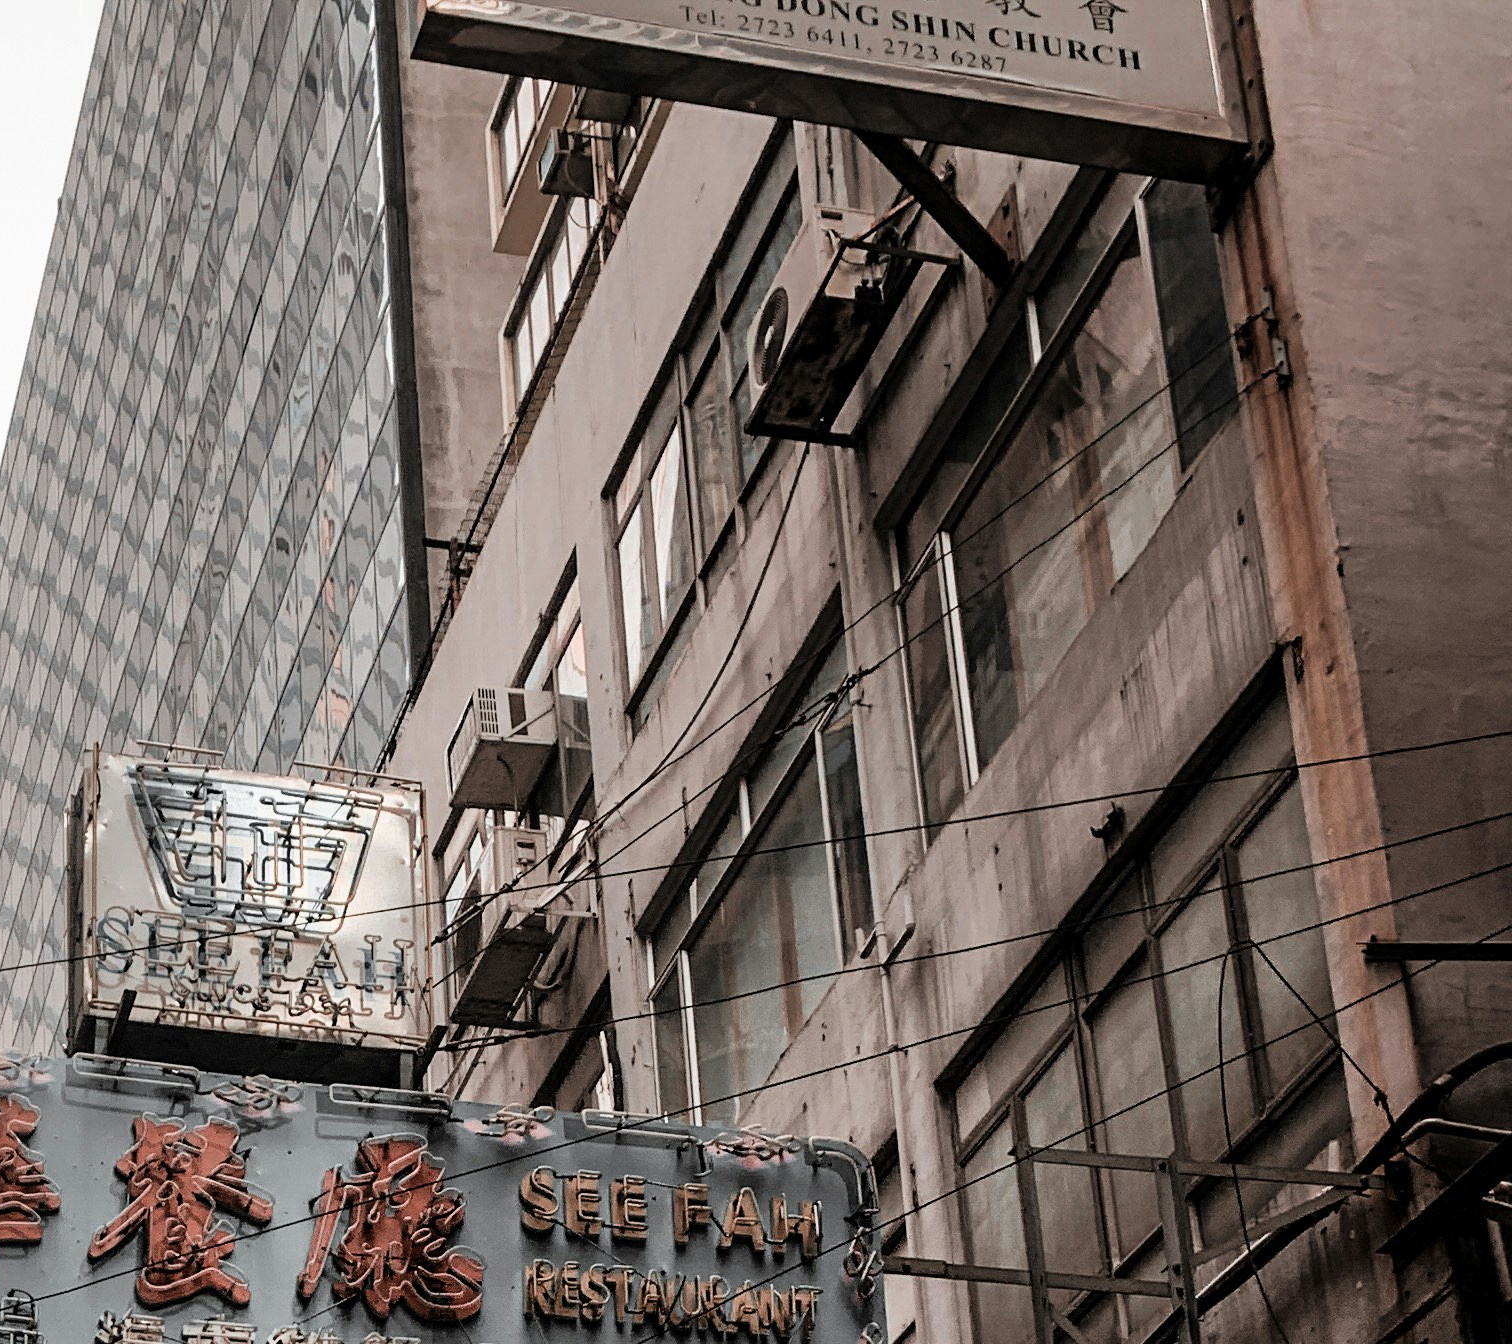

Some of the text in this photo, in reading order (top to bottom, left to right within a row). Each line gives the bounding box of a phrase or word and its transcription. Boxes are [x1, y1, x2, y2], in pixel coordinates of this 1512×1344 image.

[679, 5, 726, 28] Tel:
[737, 15, 795, 39] 2723
[806, 26, 873, 55] 6411,
[884, 38, 940, 62] 2723
[951, 49, 1007, 73] 6287
[892, 10, 976, 42] SHIN
[989, 26, 1143, 71] CHURCH
[519, 1165, 823, 1258] SEE FAH
[524, 1259, 824, 1344] RESTAURANT
